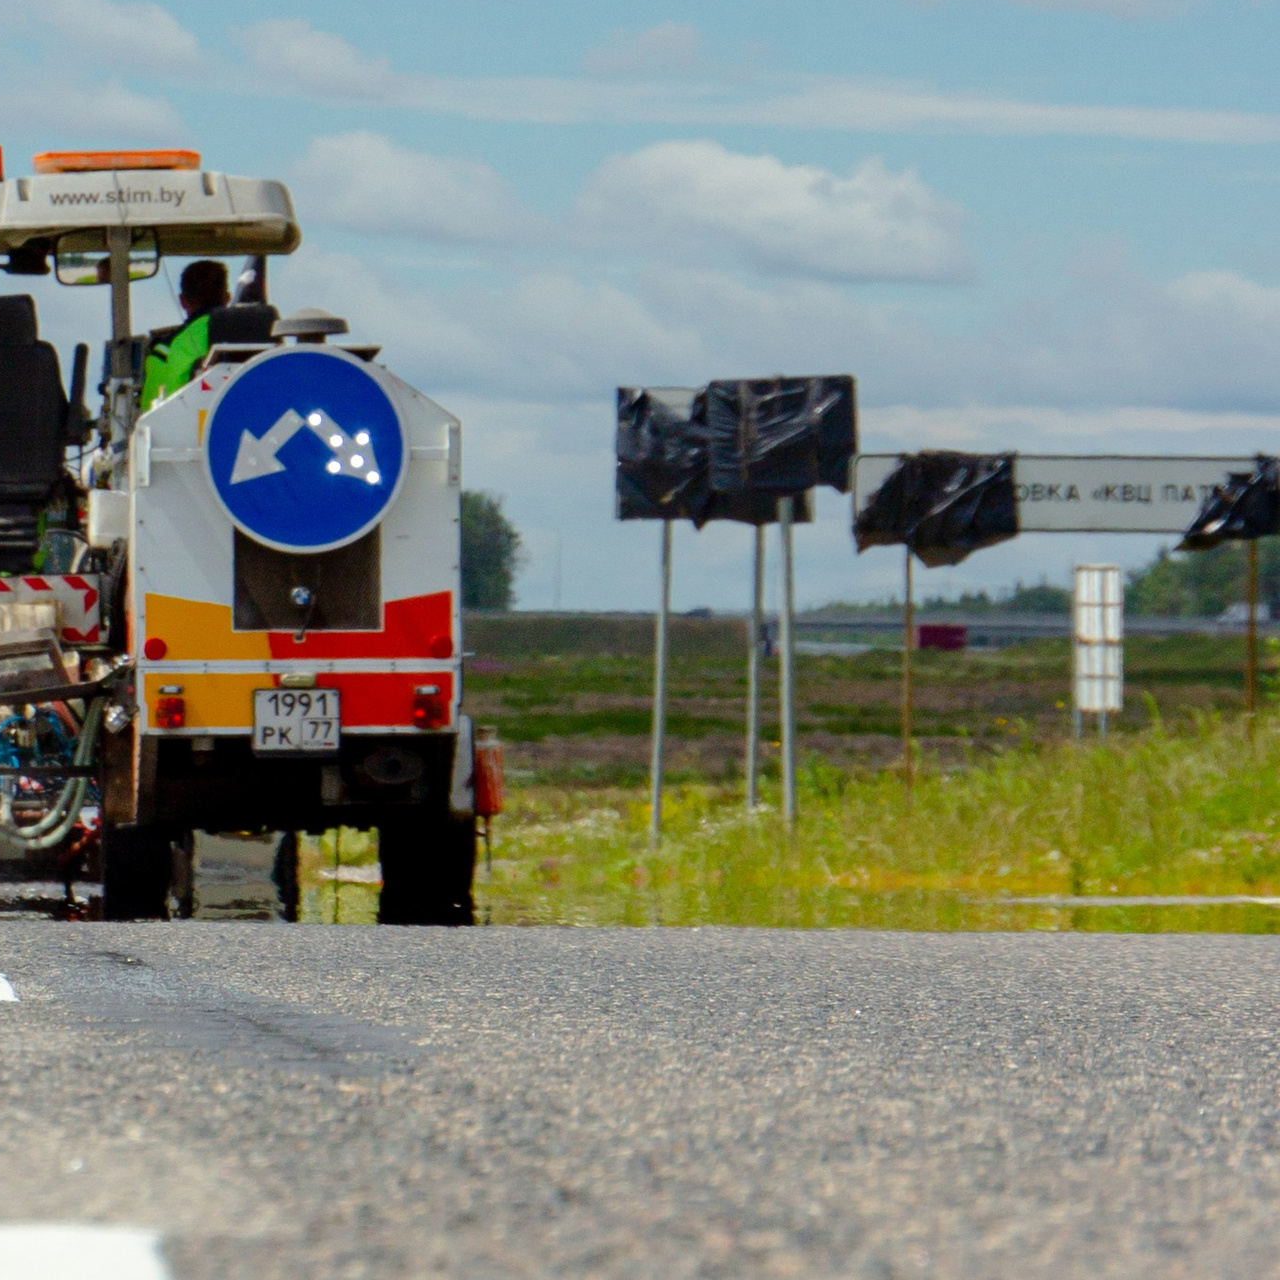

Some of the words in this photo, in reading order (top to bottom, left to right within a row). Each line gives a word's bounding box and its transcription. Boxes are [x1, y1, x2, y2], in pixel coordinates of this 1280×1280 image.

[49, 186, 186, 207] www.stim.by
[267, 693, 328, 716] 1991
[309, 721, 332, 739] 77
